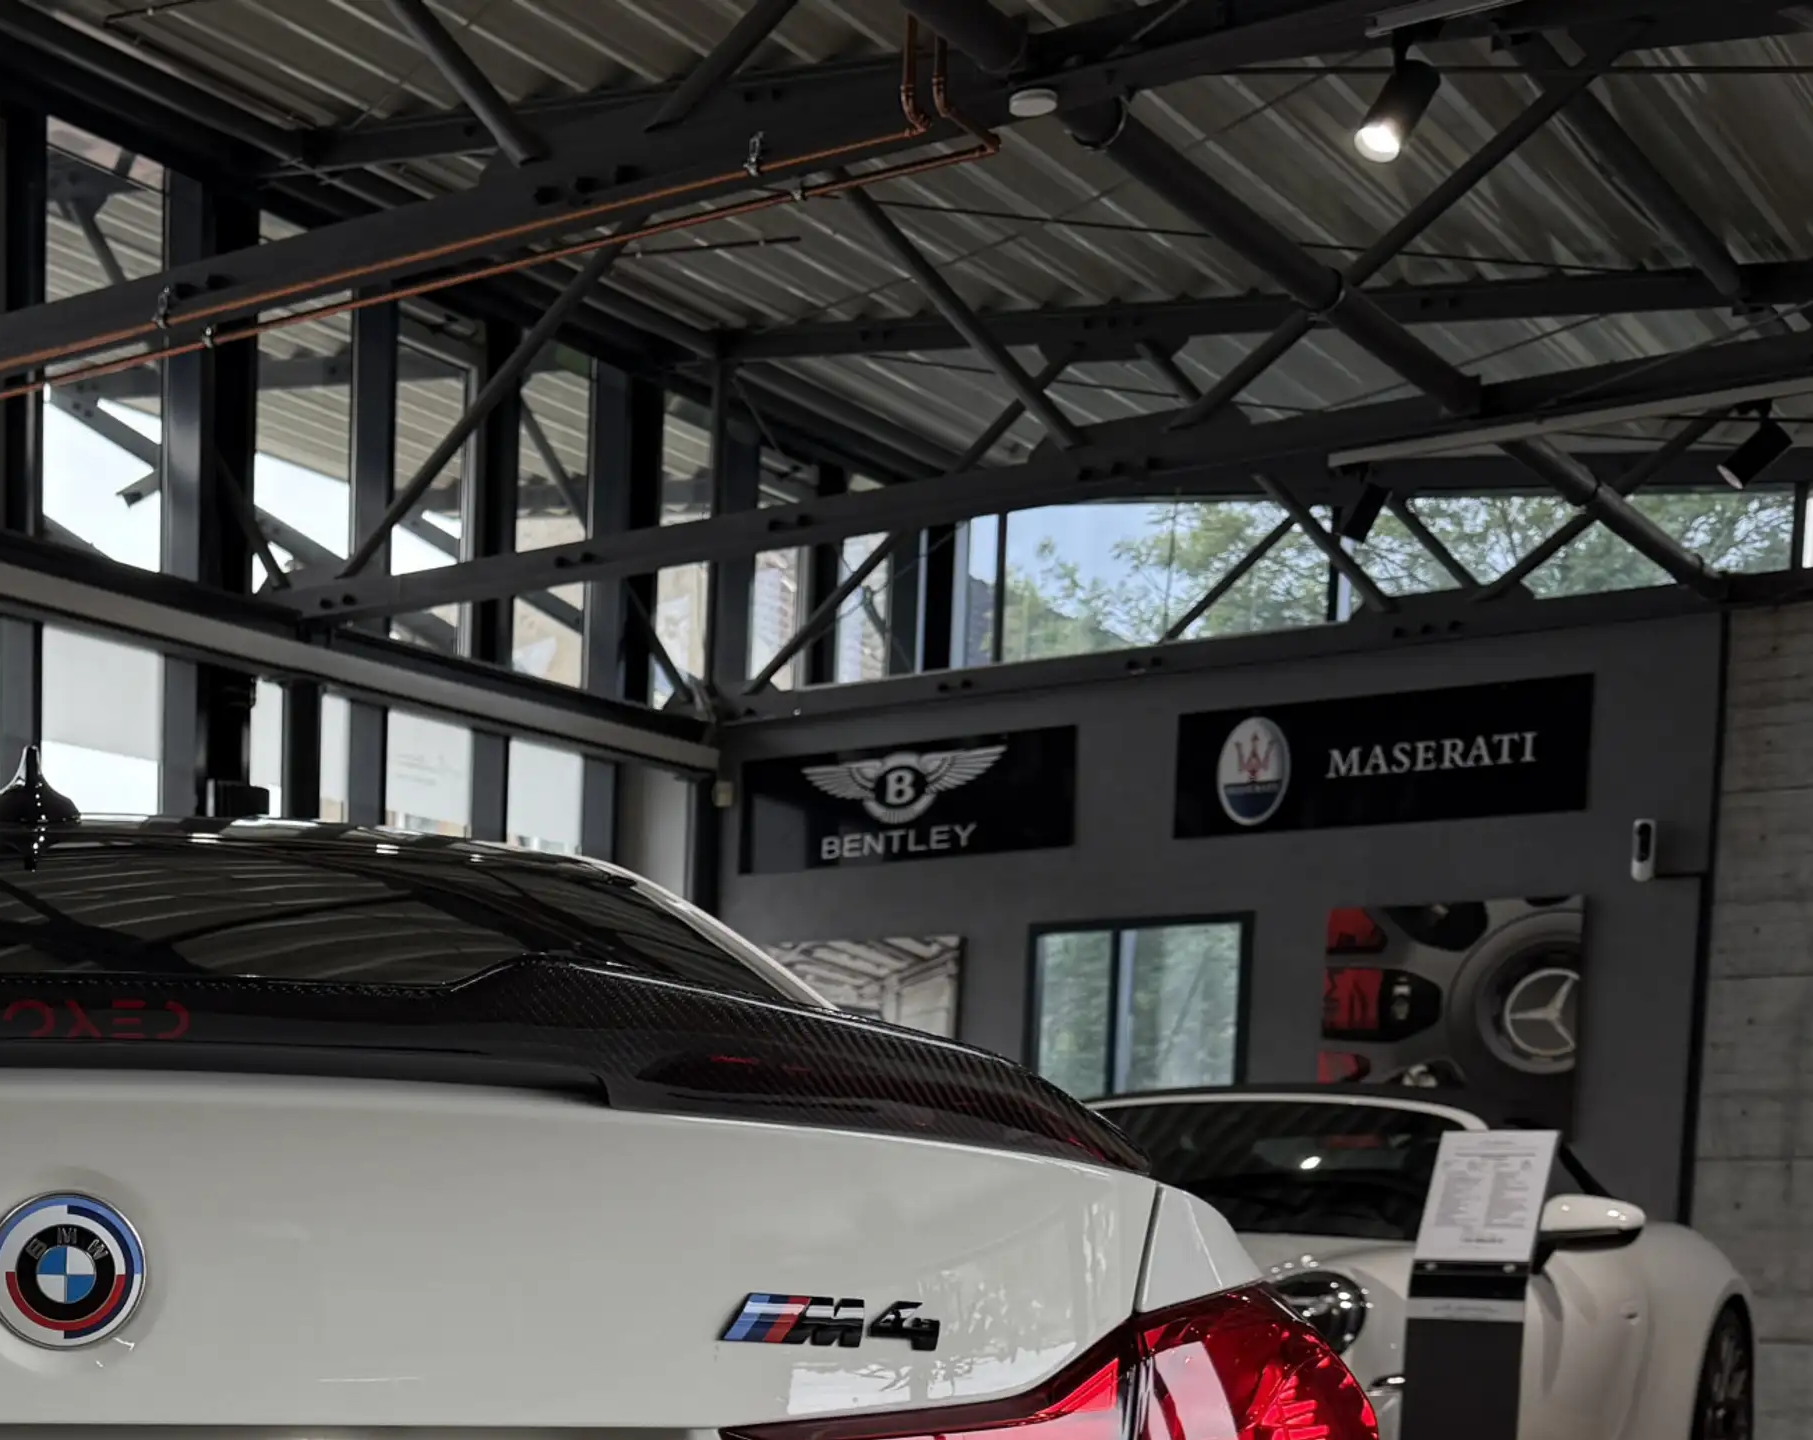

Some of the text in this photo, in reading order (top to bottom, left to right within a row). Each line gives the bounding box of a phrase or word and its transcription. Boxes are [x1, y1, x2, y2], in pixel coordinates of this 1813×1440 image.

[1325, 731, 1538, 779] MASERATI
[884, 766, 917, 805] B
[820, 822, 978, 861] BENTLEY
[26, 1227, 109, 1260] BMW
[720, 1292, 941, 1351] M4
